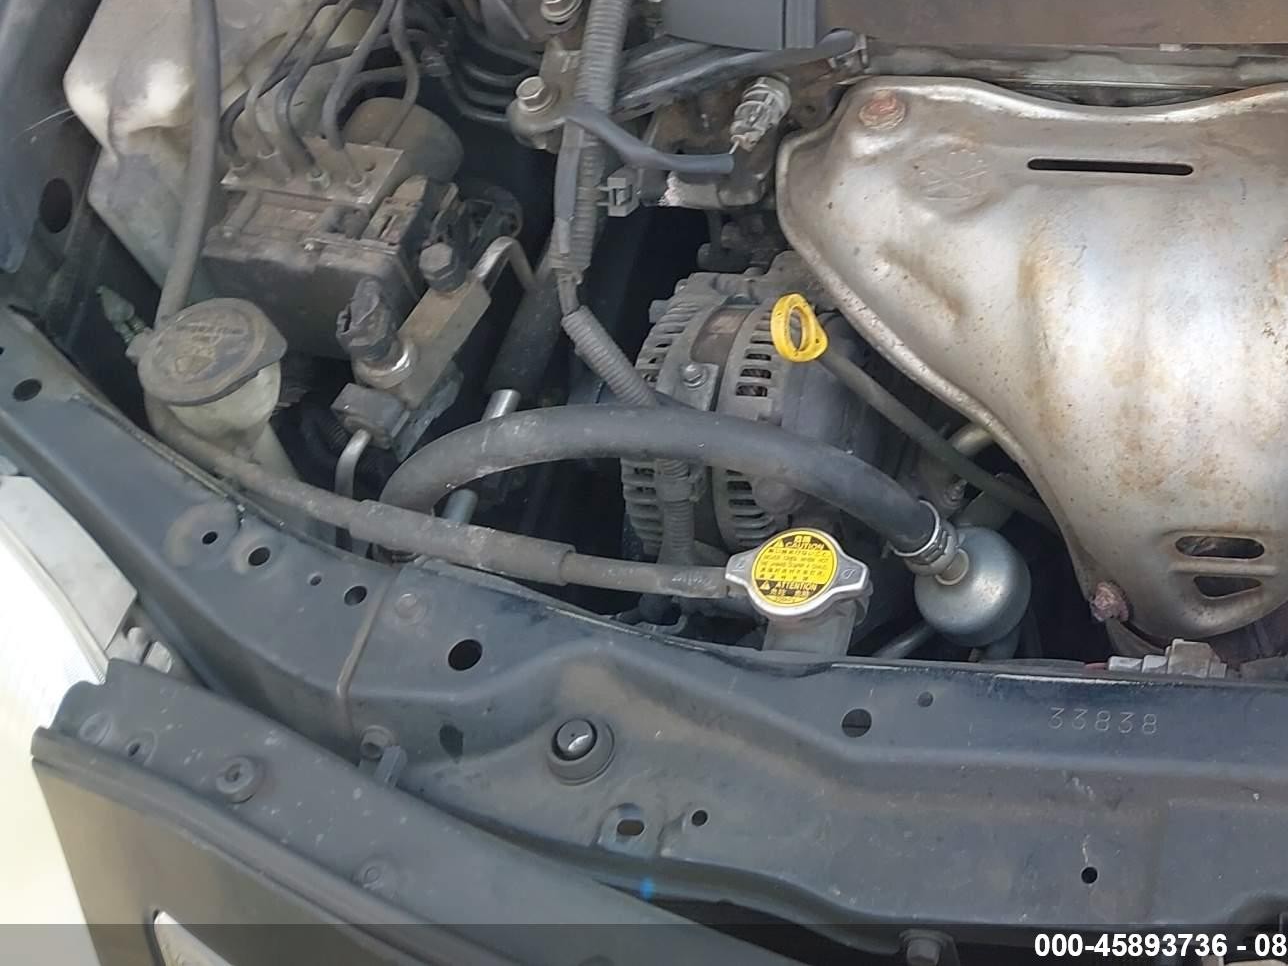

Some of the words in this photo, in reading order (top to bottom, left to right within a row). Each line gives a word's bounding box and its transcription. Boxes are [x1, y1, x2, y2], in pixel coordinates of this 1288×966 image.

[785, 541, 825, 550] CAUTION
[775, 581, 818, 591] ATTENTION
[1049, 706, 1158, 735] 33838
